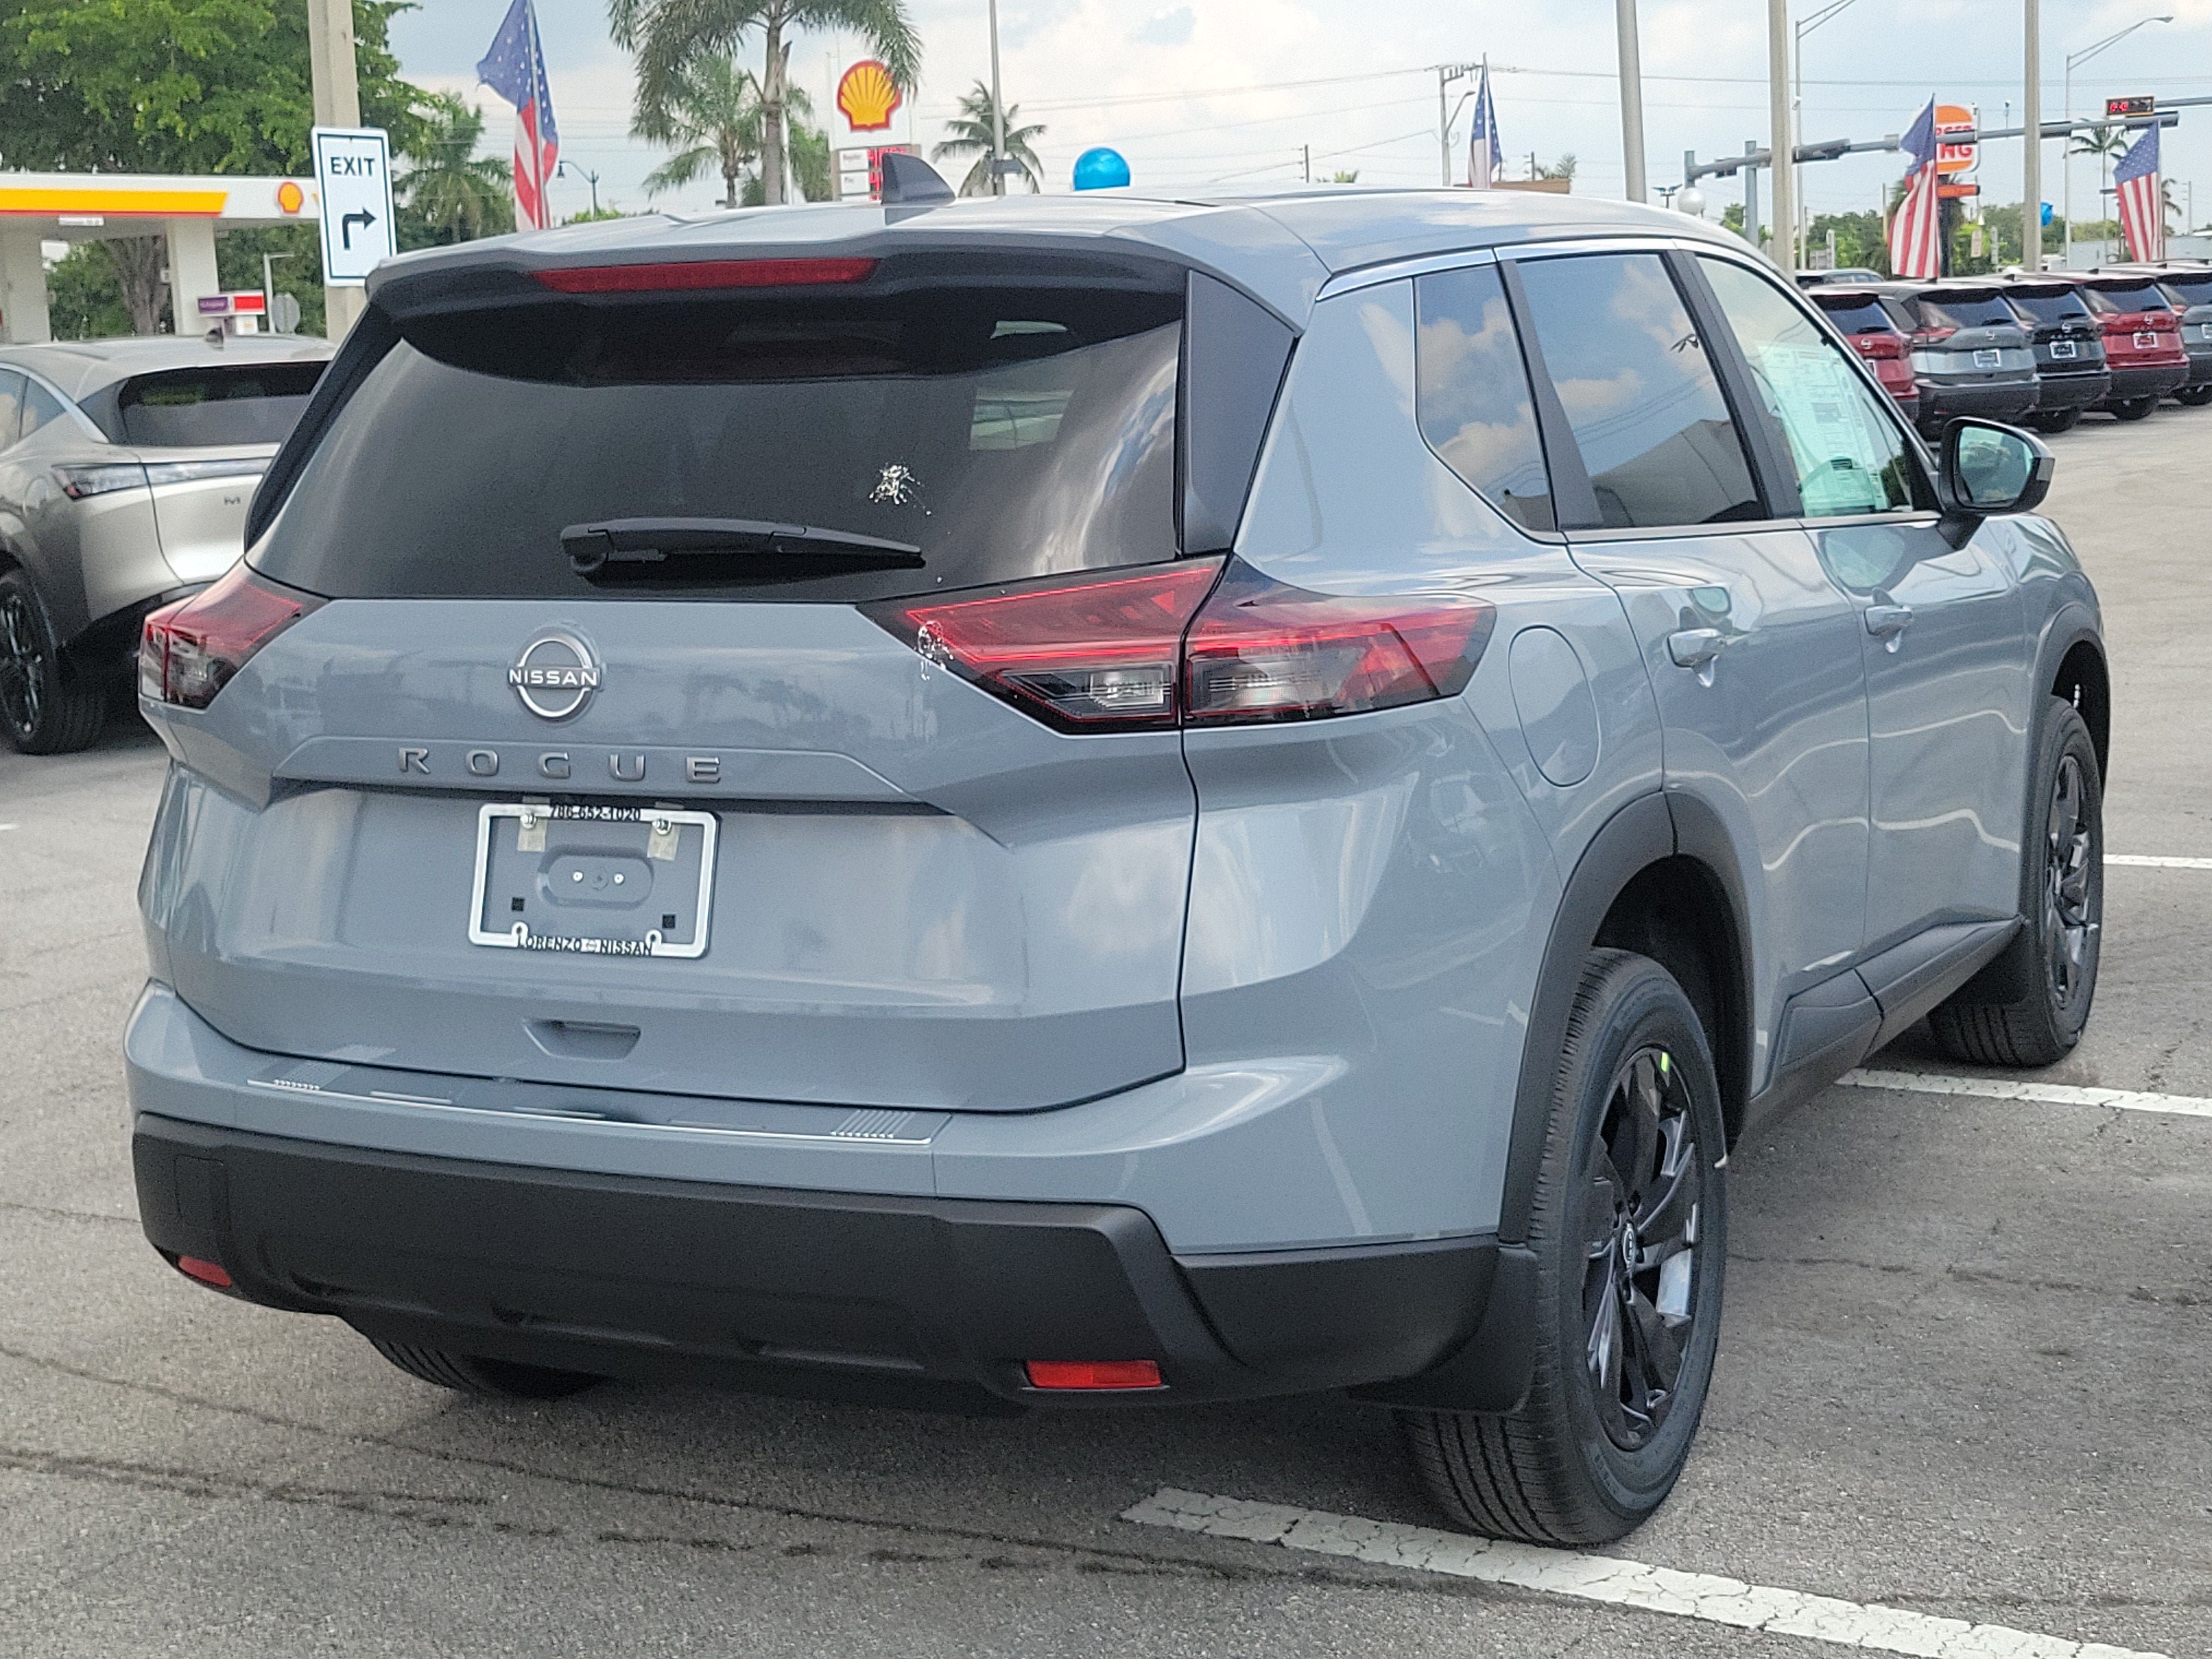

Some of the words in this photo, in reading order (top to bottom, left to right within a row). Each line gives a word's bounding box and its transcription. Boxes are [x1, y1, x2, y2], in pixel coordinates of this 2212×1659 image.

[330, 156, 375, 176] EXIT
[509, 669, 597, 686] NISSAN
[398, 748, 721, 783] ROGUE
[518, 934, 582, 952] LORENZO
[600, 939, 652, 956] NISSAN
